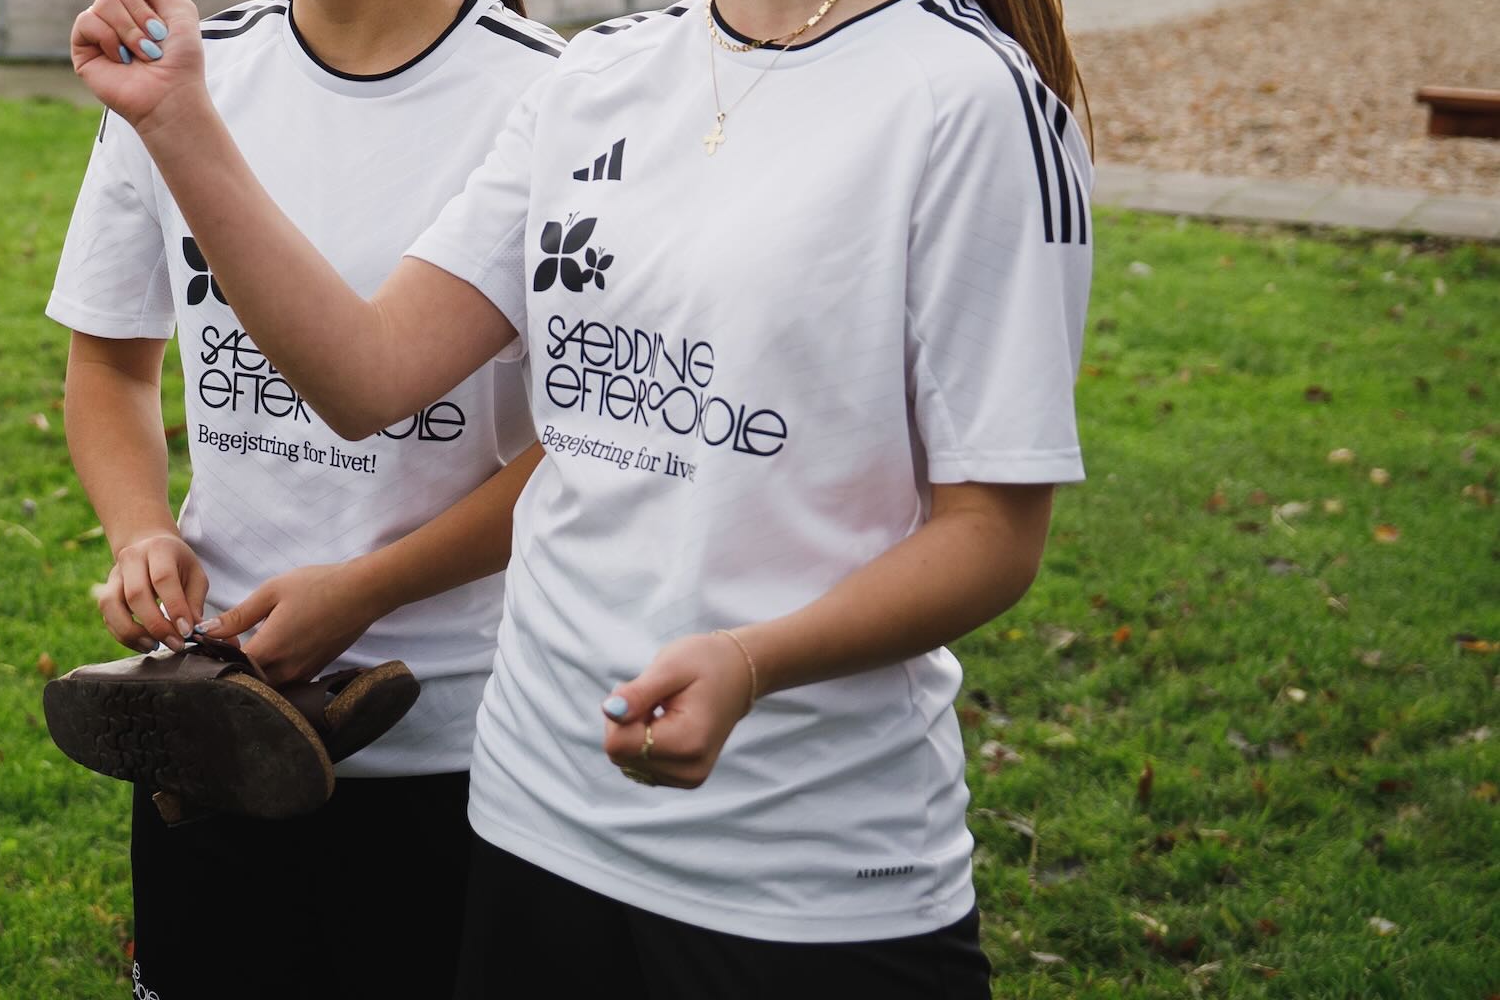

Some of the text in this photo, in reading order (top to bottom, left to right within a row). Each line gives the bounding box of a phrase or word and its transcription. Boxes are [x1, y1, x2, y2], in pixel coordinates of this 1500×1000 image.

[197, 424, 377, 474] Begejstring for livet!
[541, 425, 635, 470] Begejstring
[634, 446, 661, 473] for
